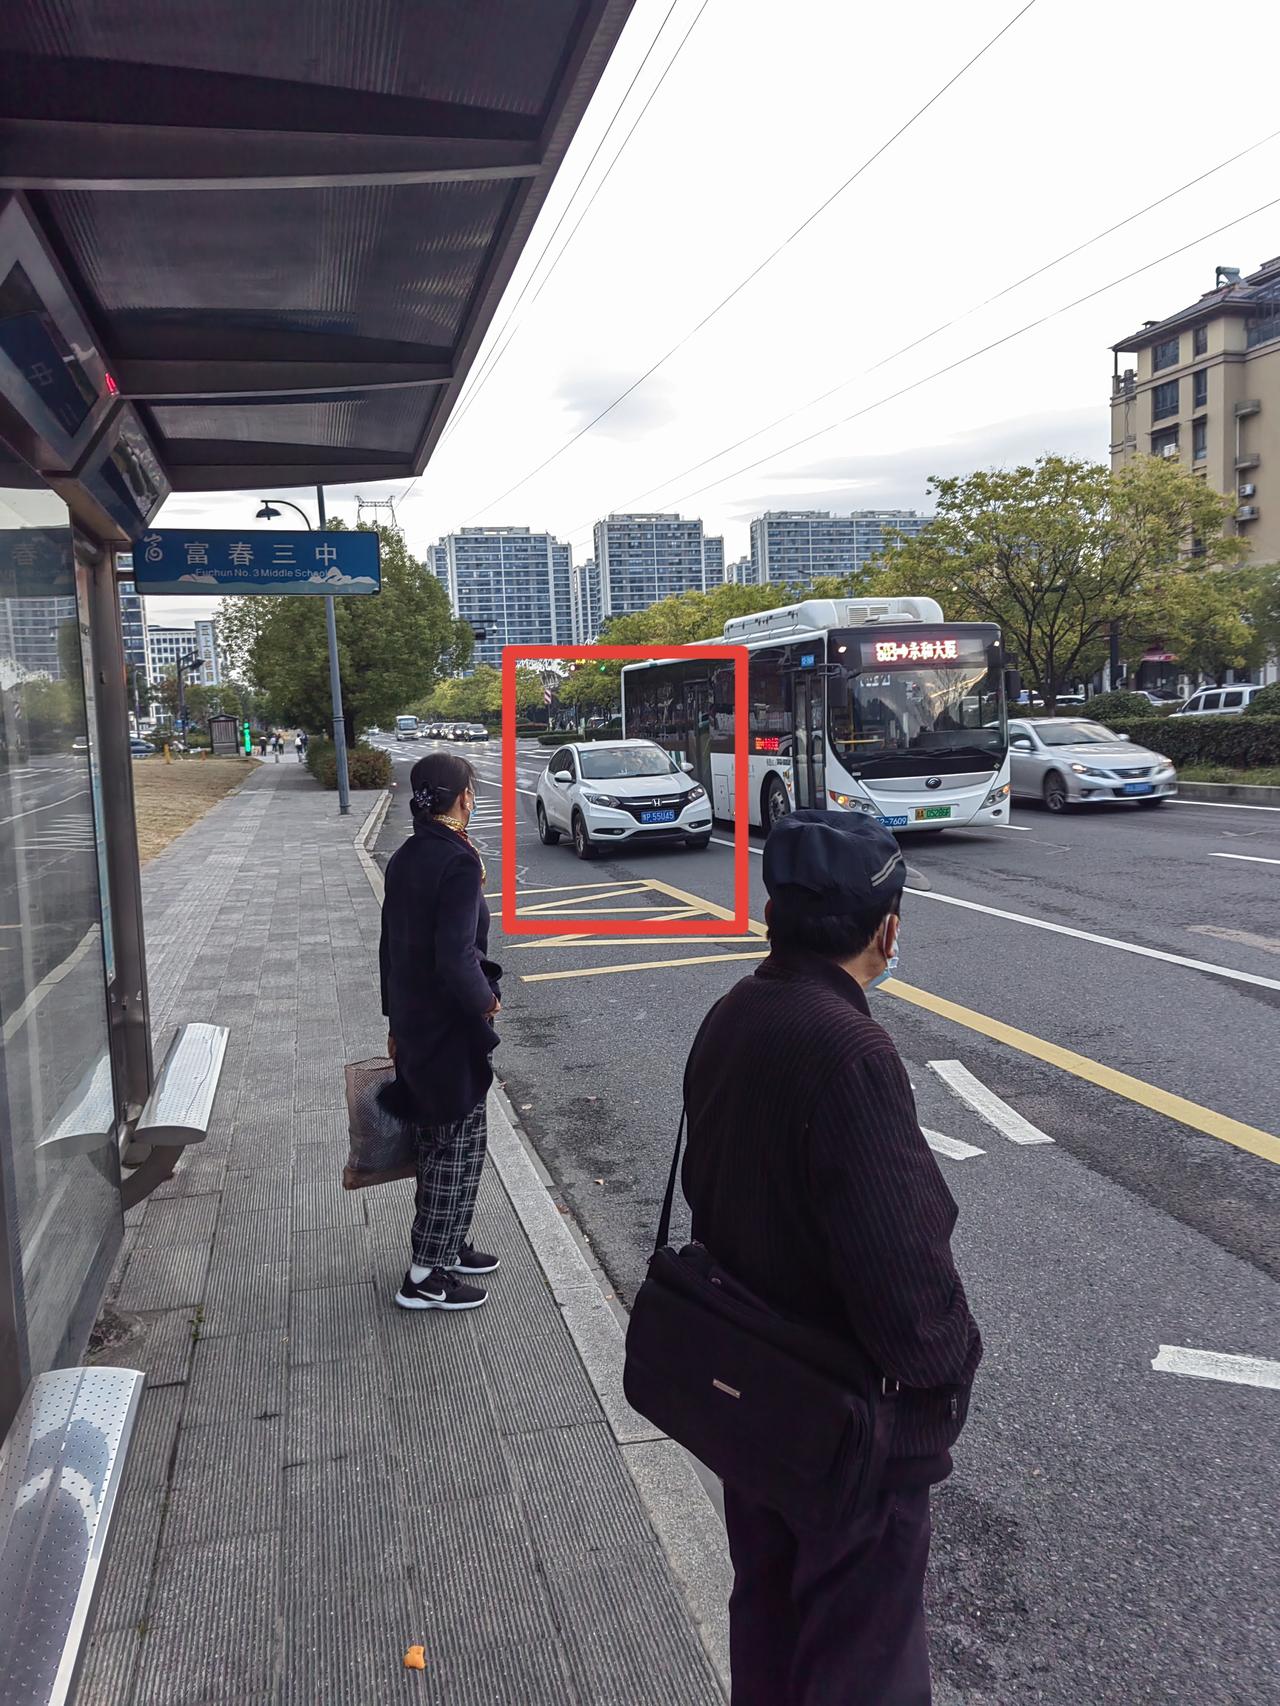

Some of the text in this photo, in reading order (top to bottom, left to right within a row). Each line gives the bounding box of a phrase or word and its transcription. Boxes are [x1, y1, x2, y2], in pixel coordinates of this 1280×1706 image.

[184, 542, 337, 566] 富春三中
[195, 568, 329, 578] Fuchun No. 3 Middle School
[876, 817, 907, 826] 2-7609
